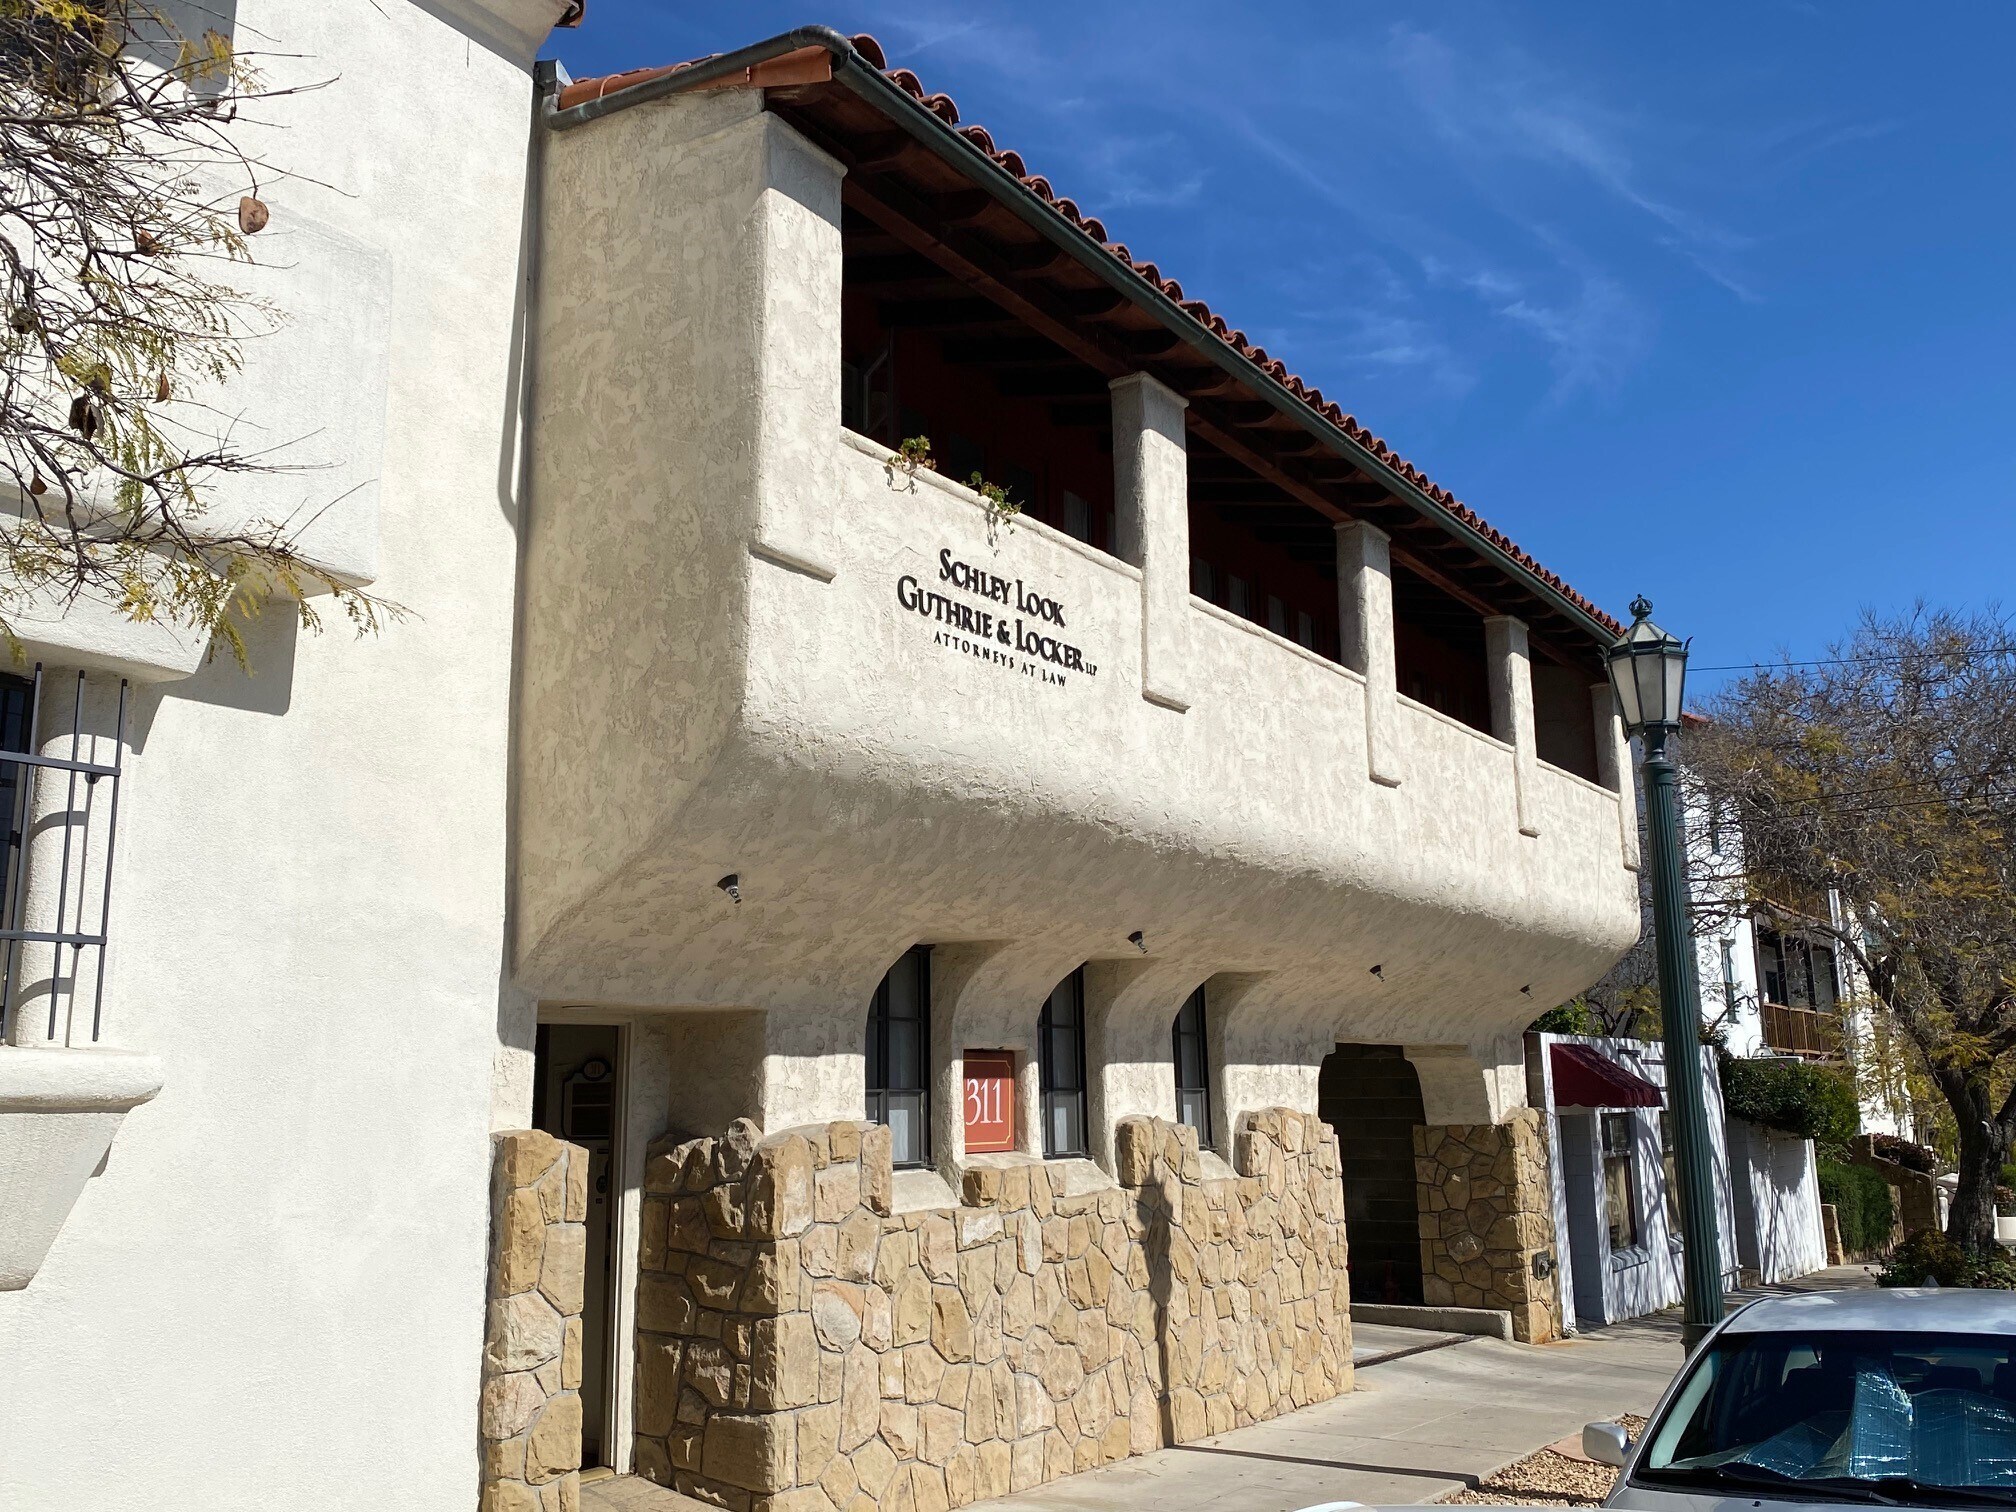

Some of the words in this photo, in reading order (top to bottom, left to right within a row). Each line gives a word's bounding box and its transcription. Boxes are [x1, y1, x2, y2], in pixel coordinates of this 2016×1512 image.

[939, 548, 1012, 605] SCHLEY
[1016, 579, 1066, 629] LOOK
[897, 575, 993, 640] GUTHRIE
[996, 619, 1012, 647] &
[1015, 618, 1085, 673] LOCKER
[1085, 662, 1098, 677] LLP
[933, 631, 1015, 669] ATTORNEYS
[1021, 662, 1036, 677] AT
[1042, 668, 1067, 687] LAW
[965, 1078, 1004, 1126] 311
